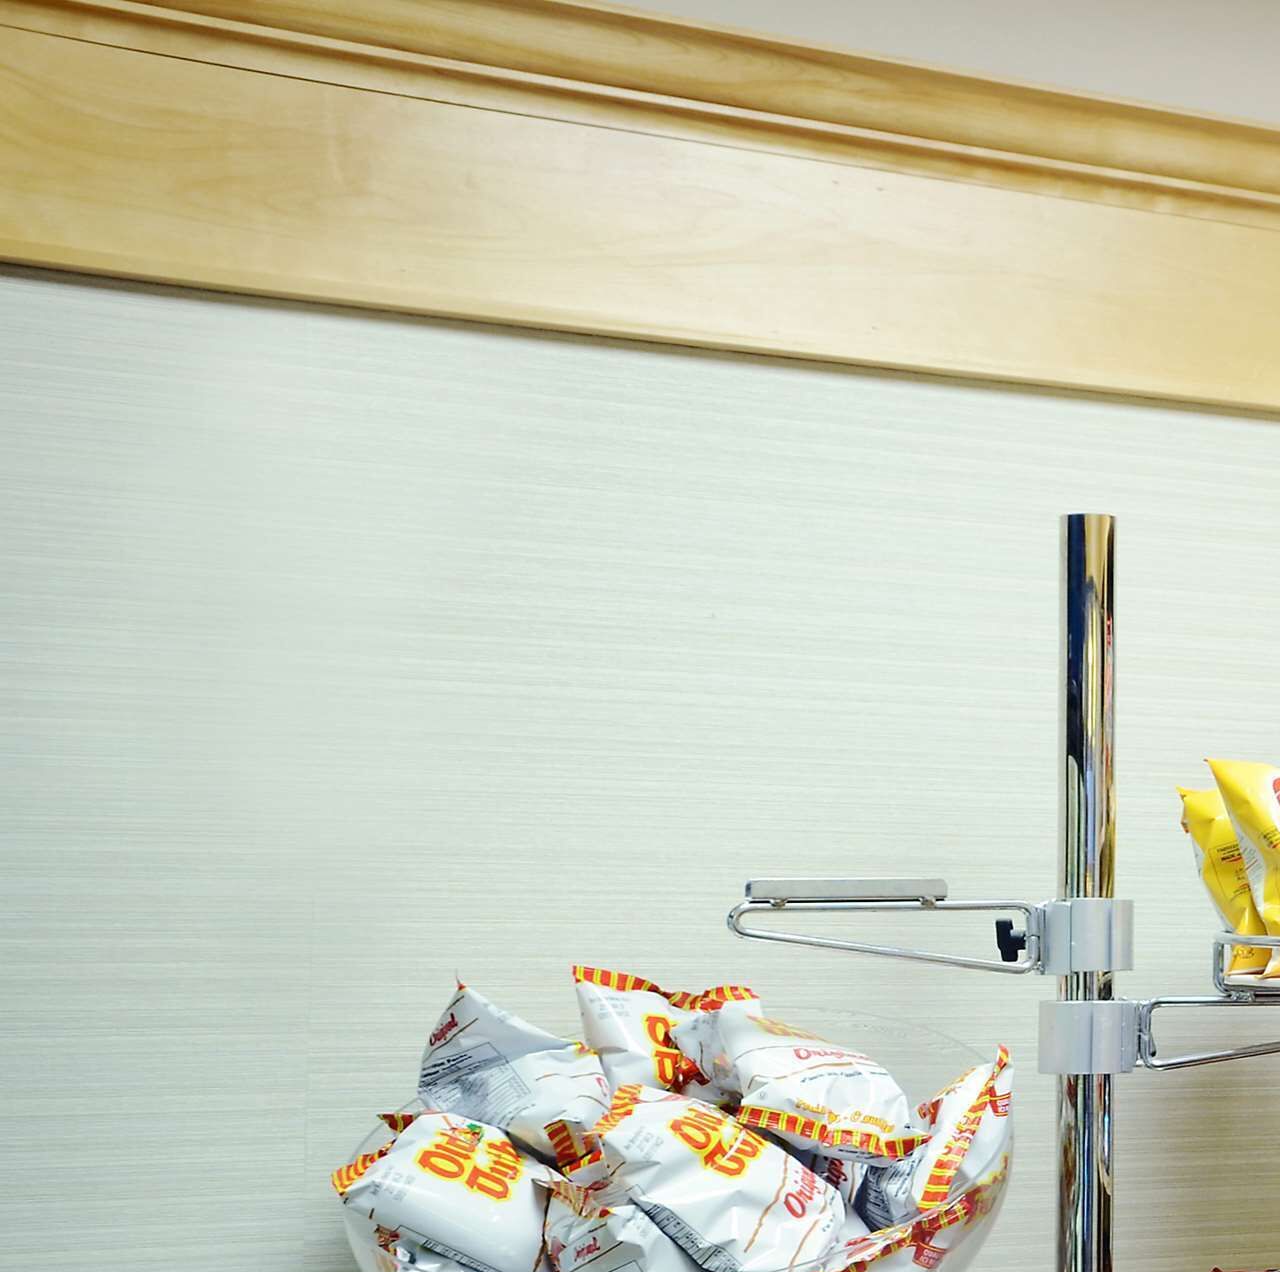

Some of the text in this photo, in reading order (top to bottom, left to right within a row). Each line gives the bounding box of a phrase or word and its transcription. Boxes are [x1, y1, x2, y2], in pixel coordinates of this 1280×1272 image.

[669, 1106, 726, 1151] Old
[418, 1130, 478, 1180] Old
[783, 1166, 820, 1219] Origi
